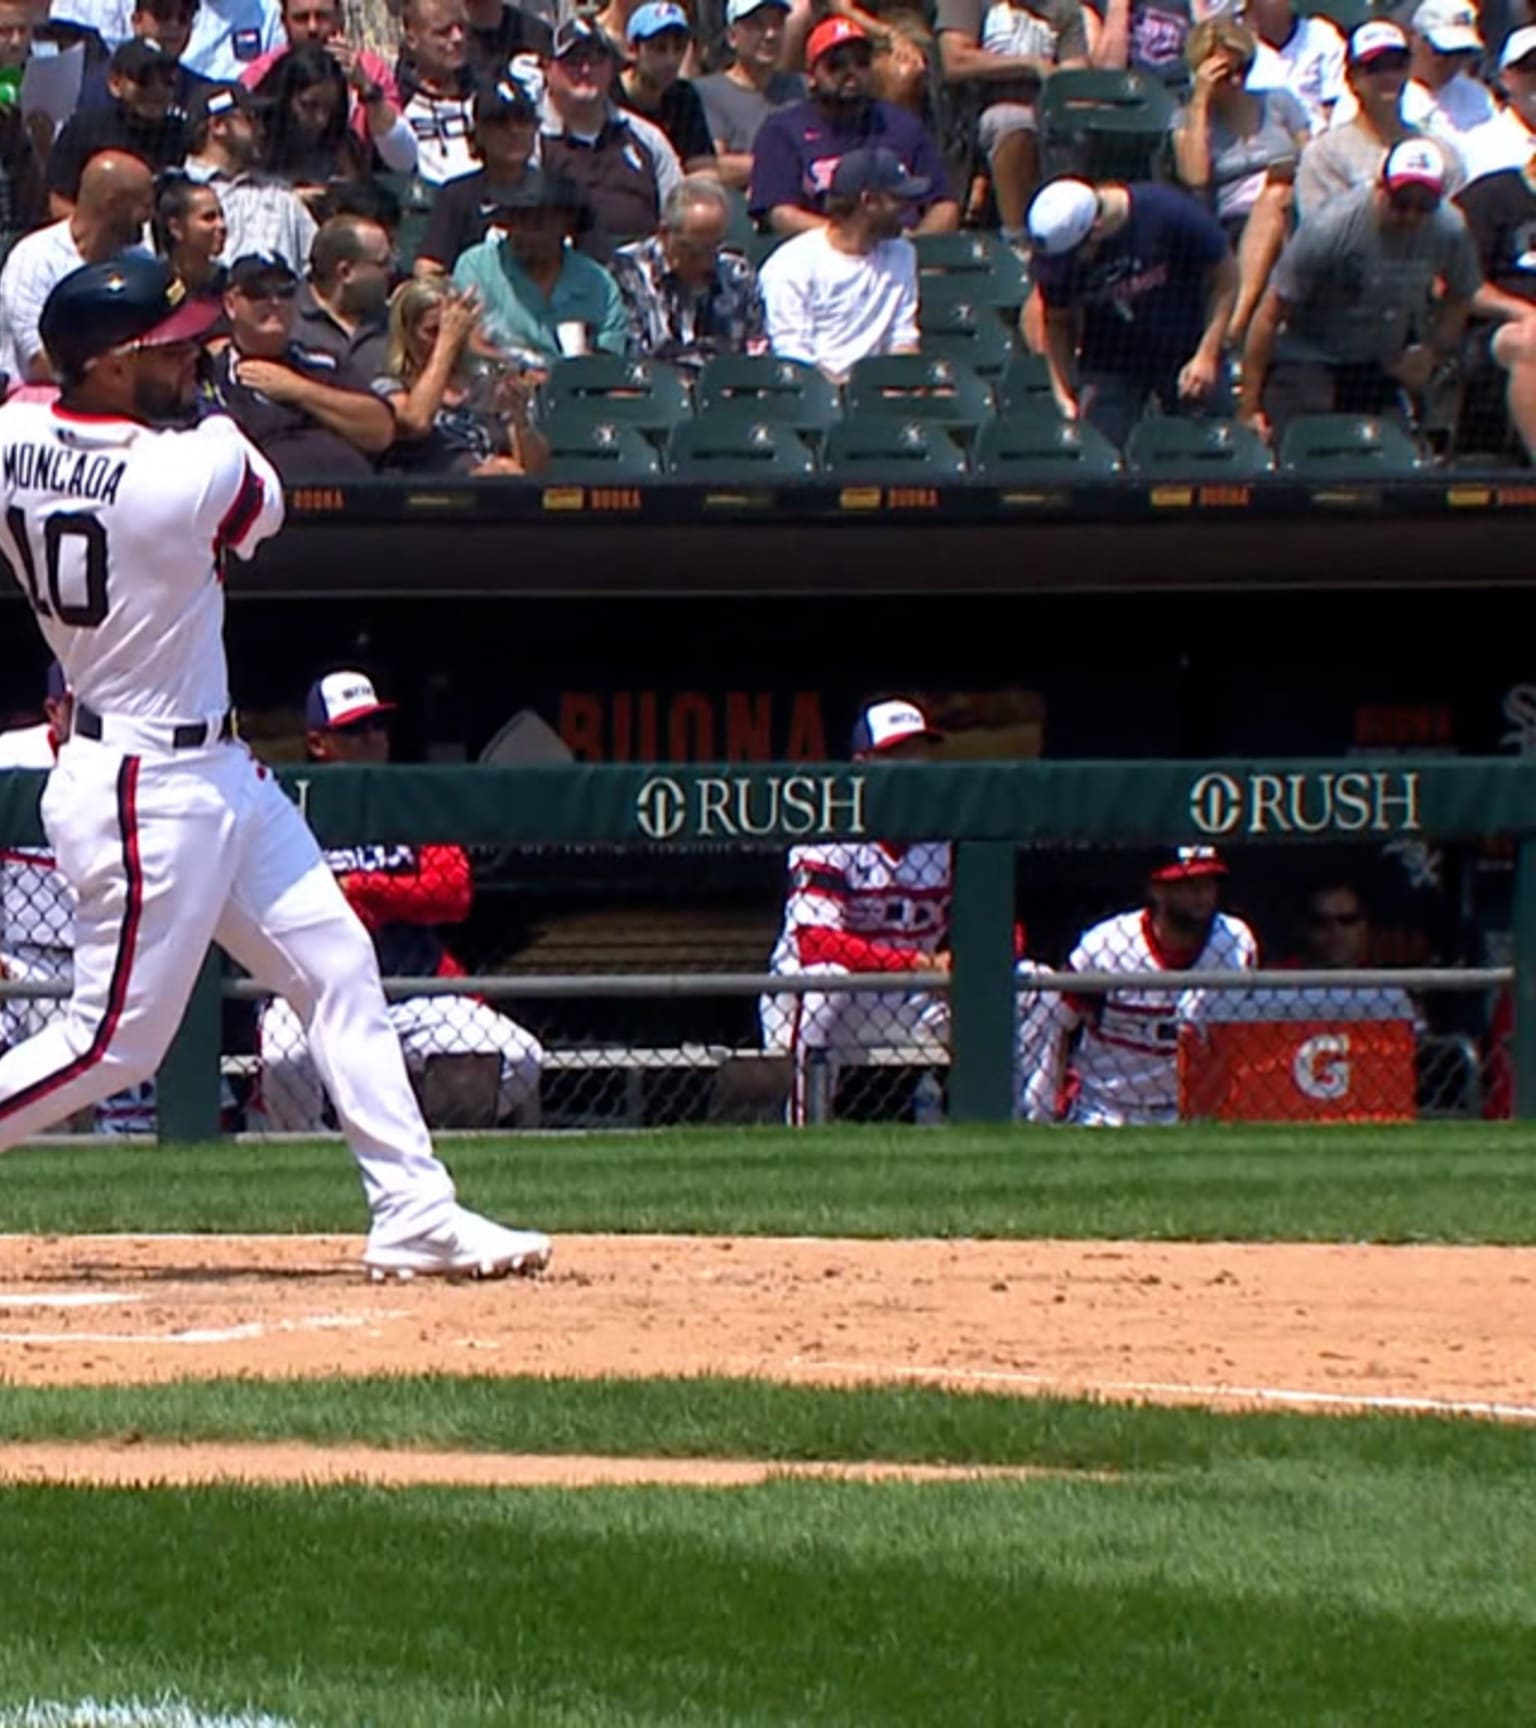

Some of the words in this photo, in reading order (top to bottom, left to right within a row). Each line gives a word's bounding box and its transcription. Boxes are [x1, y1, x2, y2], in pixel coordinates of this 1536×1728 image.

[3, 443, 127, 505] MONCADA
[6, 505, 109, 628] 10
[695, 776, 866, 834] RUSH
[1247, 772, 1420, 833] RUSH
[1294, 1034, 1351, 1099] G
